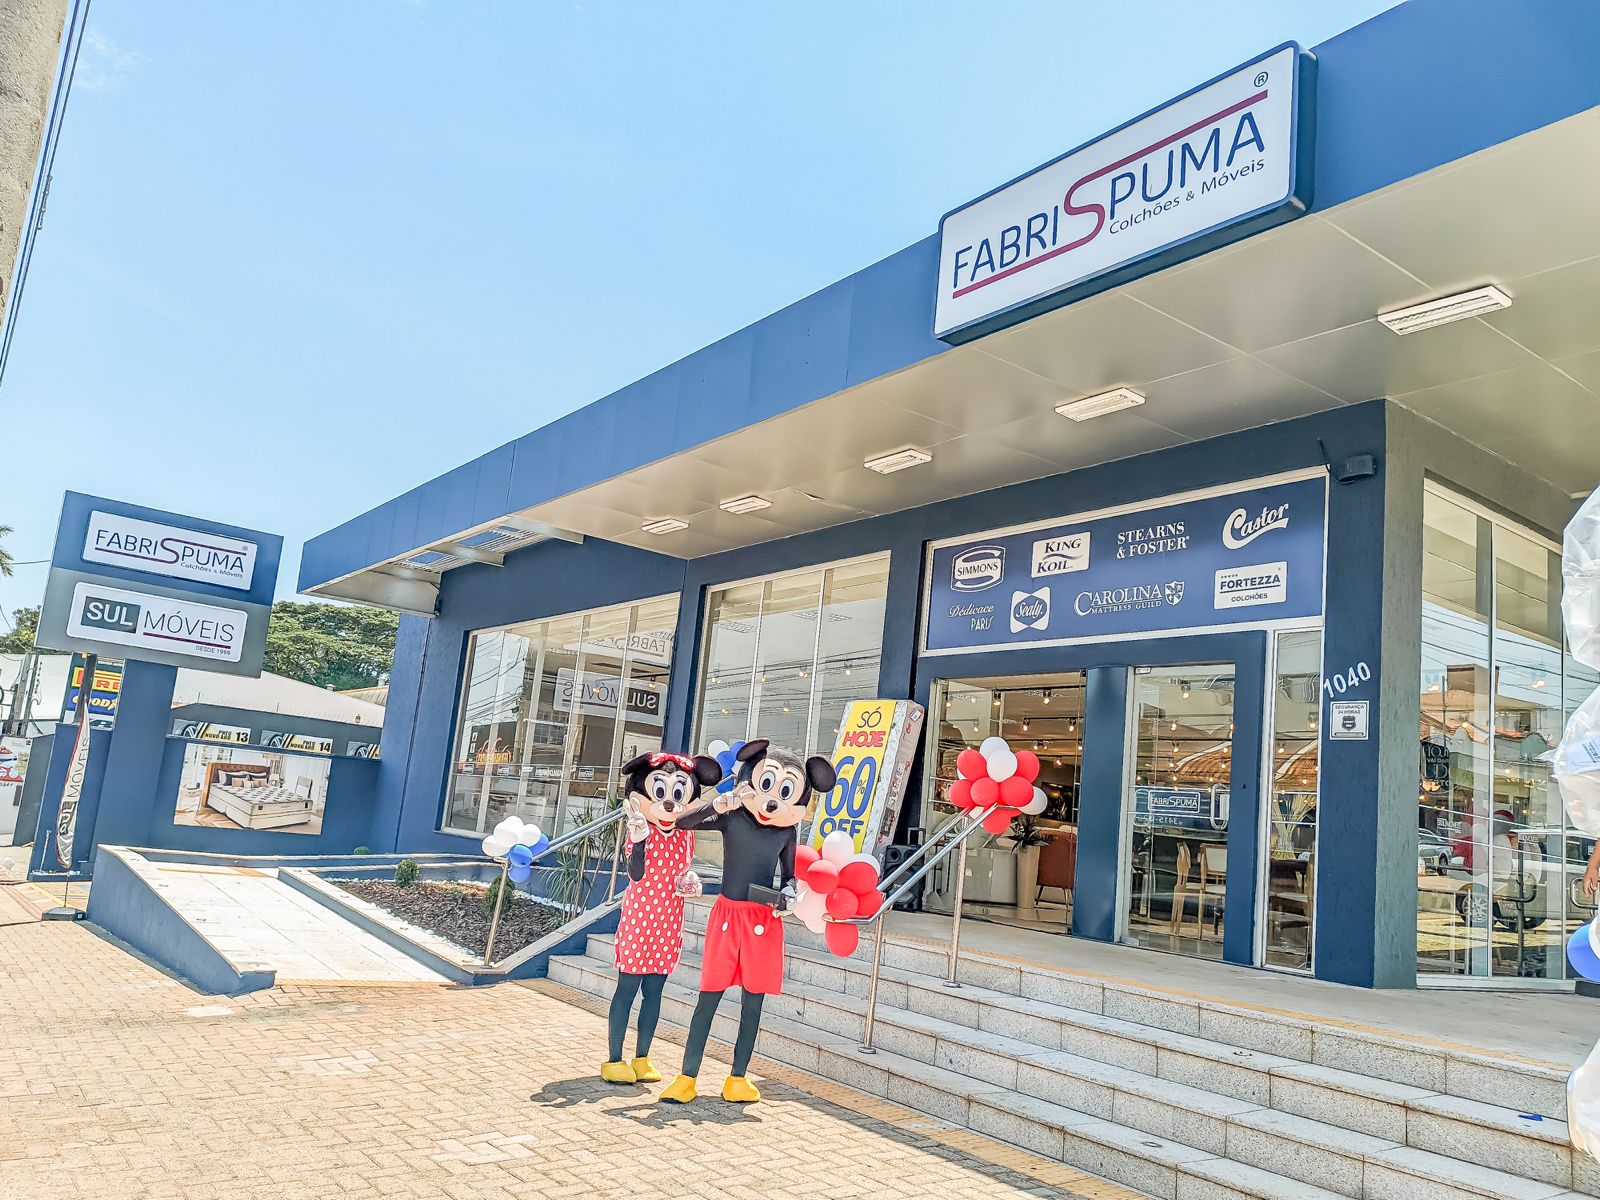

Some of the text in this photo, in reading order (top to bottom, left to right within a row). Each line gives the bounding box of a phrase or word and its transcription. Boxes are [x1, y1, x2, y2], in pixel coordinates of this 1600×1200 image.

[952, 109, 1266, 290] FABRISPUMA
[1109, 157, 1266, 235] Colchões & Móveis
[1117, 521, 1186, 545] STEARNS
[1222, 503, 1290, 550] Castor
[95, 529, 245, 573] FABRISPUMA
[1044, 537, 1082, 554] KING
[1116, 537, 1188, 560] & FOSTER
[957, 561, 999, 577] SIMMONS
[1036, 559, 1070, 575] KOIL
[1219, 574, 1281, 591] FORTEZZA
[1073, 583, 1163, 617] CAROLINA
[1230, 592, 1268, 603] COLCHÕES
[948, 603, 995, 618] Dédicace
[1091, 599, 1162, 615] MATTRESS GUILD
[86, 601, 235, 643] SUL MÓVEIS
[195, 645, 215, 654] DESDE
[1323, 661, 1371, 698] 1040
[856, 705, 882, 729] SÓ
[235, 731, 249, 743] 13
[842, 731, 887, 748] HOJE
[319, 741, 331, 753] 14
[1150, 795, 1198, 808] FABRISPUMA
[820, 818, 864, 840] OFF
